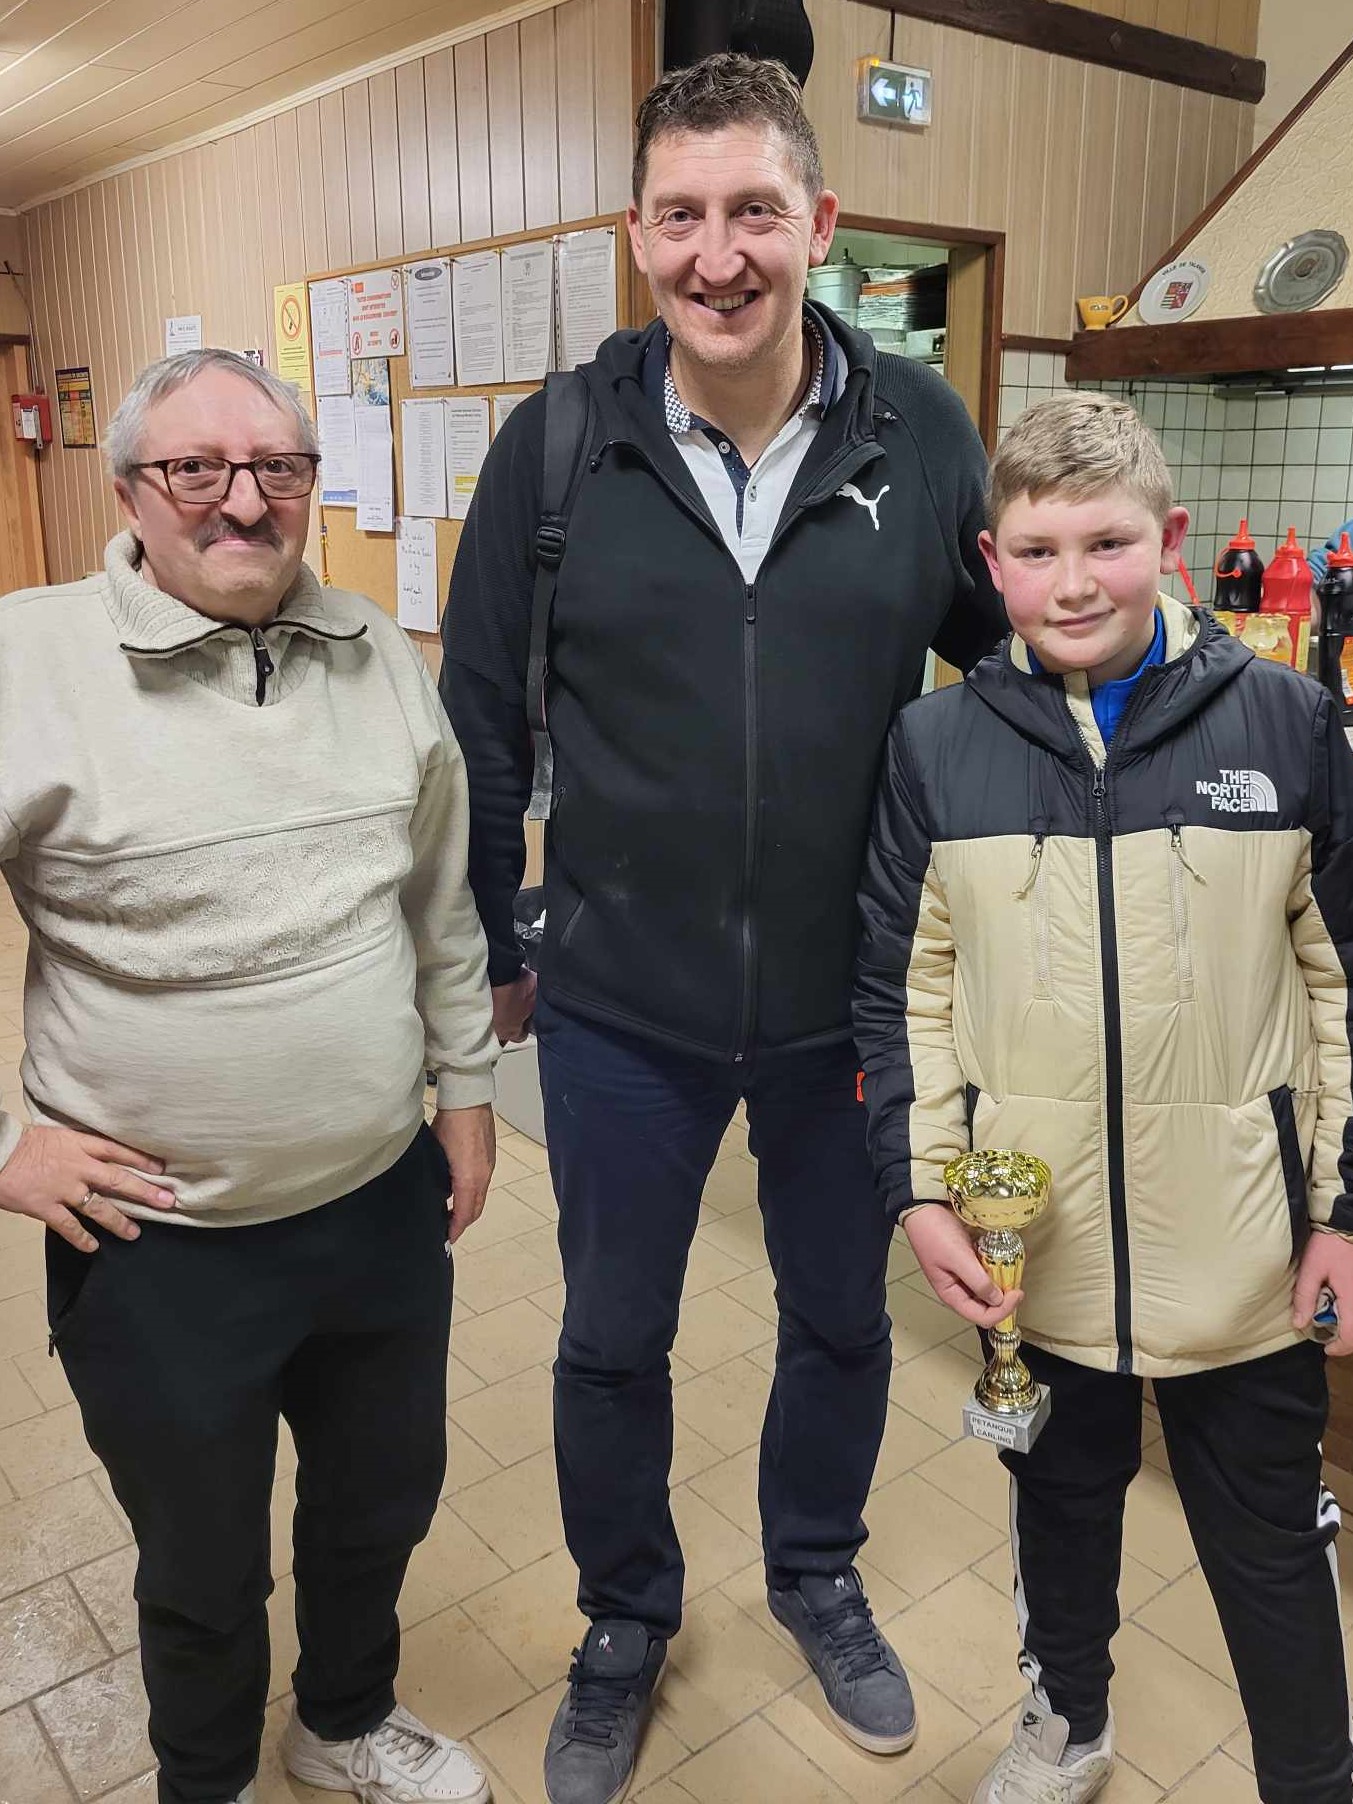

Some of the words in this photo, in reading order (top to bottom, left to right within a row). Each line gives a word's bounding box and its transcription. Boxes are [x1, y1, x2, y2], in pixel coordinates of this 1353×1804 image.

[1219, 769, 1250, 784] THE
[1196, 780, 1250, 798] NORTH
[1211, 796, 1251, 813] FACE
[972, 1416, 1014, 1434] PETANQUE
[977, 1428, 1012, 1445] CARLING
